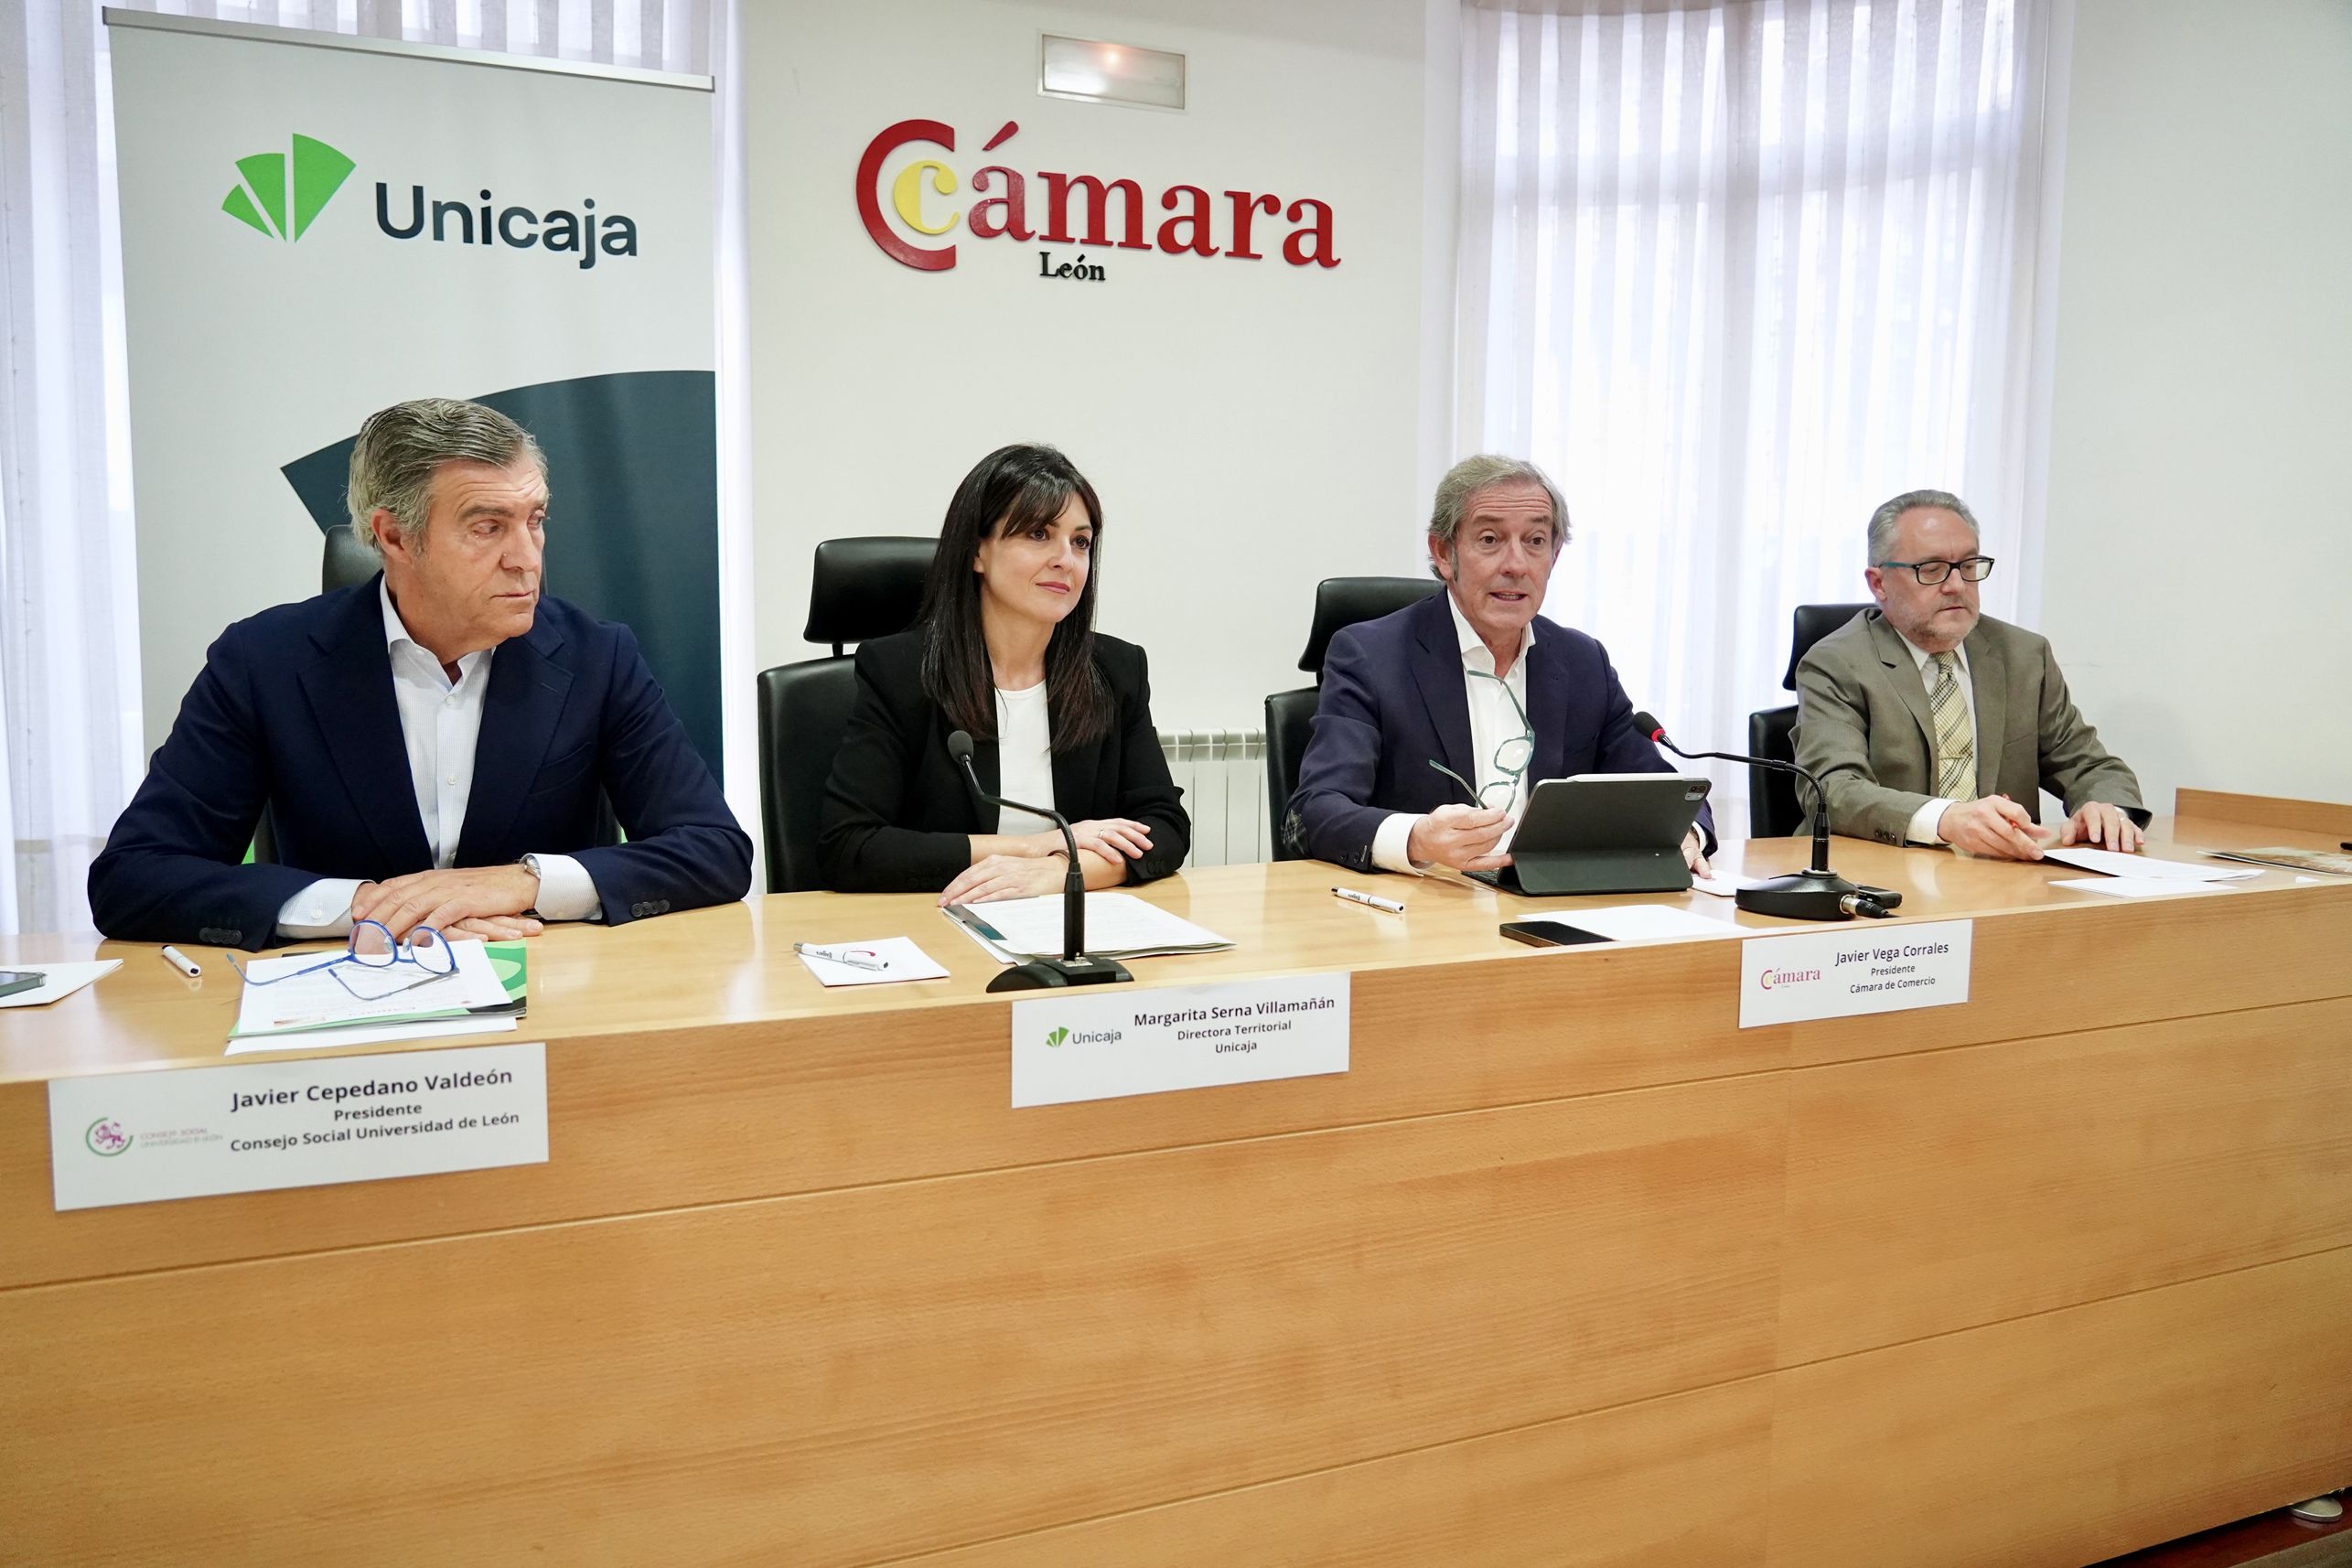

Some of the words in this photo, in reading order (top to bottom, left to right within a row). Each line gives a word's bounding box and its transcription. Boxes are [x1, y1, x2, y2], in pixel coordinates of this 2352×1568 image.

[375, 181, 639, 270] Unicaja
[1038, 252, 1107, 282] León
[1835, 949, 1870, 967] Javier
[1873, 946, 1900, 962] Vega
[1903, 941, 1949, 957] Corrales
[1871, 963, 1916, 977] Presidente
[1850, 981, 1883, 993] Cámara
[1885, 981, 1896, 991] de
[1898, 976, 1936, 989] Comercio
[1133, 1008, 1208, 1028] Margarita
[1210, 1004, 1252, 1020] Serna
[1256, 997, 1336, 1015] Villamañán
[1071, 1029, 1122, 1046] Unicaja
[1177, 1026, 1232, 1041] Directora
[1235, 1020, 1292, 1035] Territorial
[1215, 1039, 1258, 1054] Unicaja
[231, 1089, 299, 1112] Javier
[306, 1079, 418, 1104] Cepedano
[424, 1069, 512, 1091] Valdeón
[334, 1104, 422, 1122] Presidente
[231, 1134, 298, 1151] Consejo
[303, 1127, 351, 1144] Social
[357, 1118, 454, 1140] Universidad
[458, 1116, 478, 1130] de
[482, 1112, 520, 1127] León
